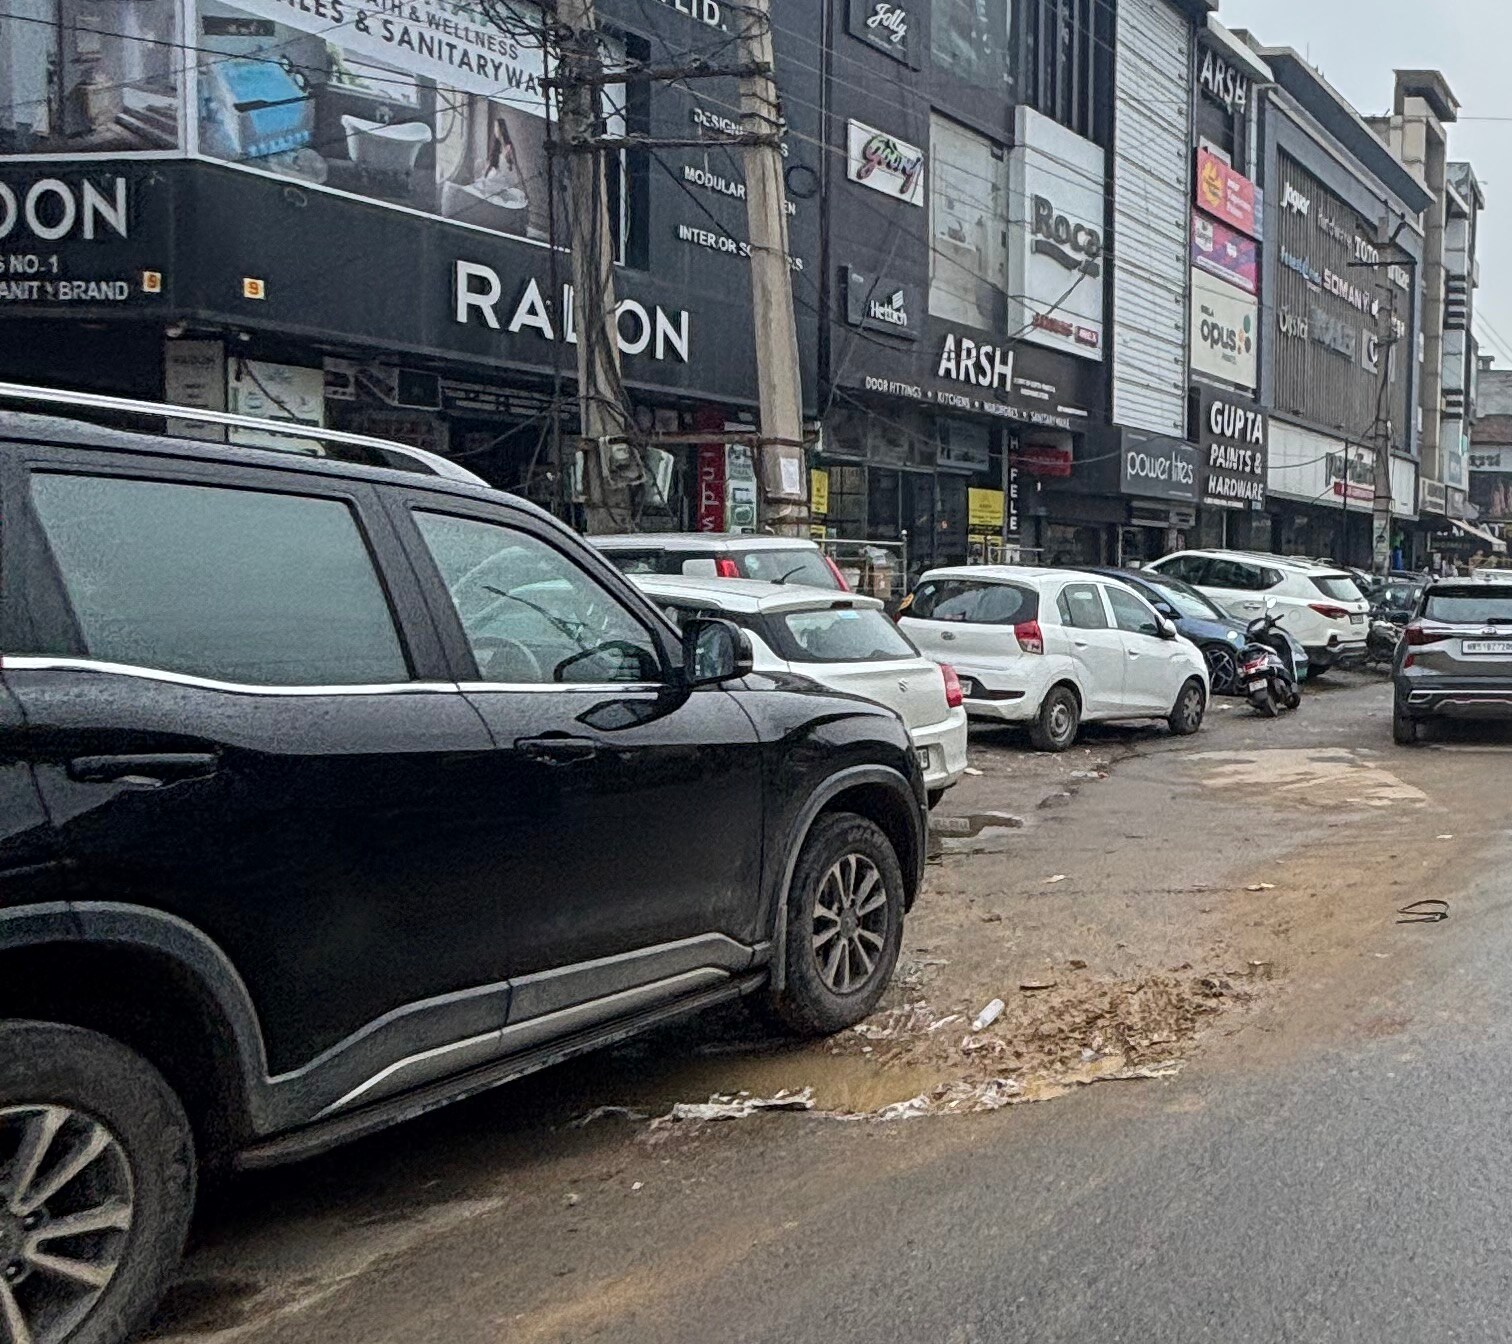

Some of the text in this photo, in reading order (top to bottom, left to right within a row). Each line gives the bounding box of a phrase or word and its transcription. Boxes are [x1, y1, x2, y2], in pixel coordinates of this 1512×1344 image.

[355, 9, 371, 36] &
[426, 9, 518, 61] WELLNESS
[866, 2, 907, 43] Jolly
[1200, 48, 1248, 114] ARSH
[684, 165, 746, 200] MODULAR
[1031, 193, 1102, 258] Roca
[58, 280, 129, 301] BRAND
[1200, 318, 1237, 353] opus
[938, 332, 1015, 393] ARSH
[865, 375, 888, 393] DOOR
[1210, 400, 1263, 445] GUPTA
[1209, 443, 1262, 476] PAINTS &
[1009, 435, 1020, 531] HFELE
[1208, 473, 1264, 501] HARDWARE
